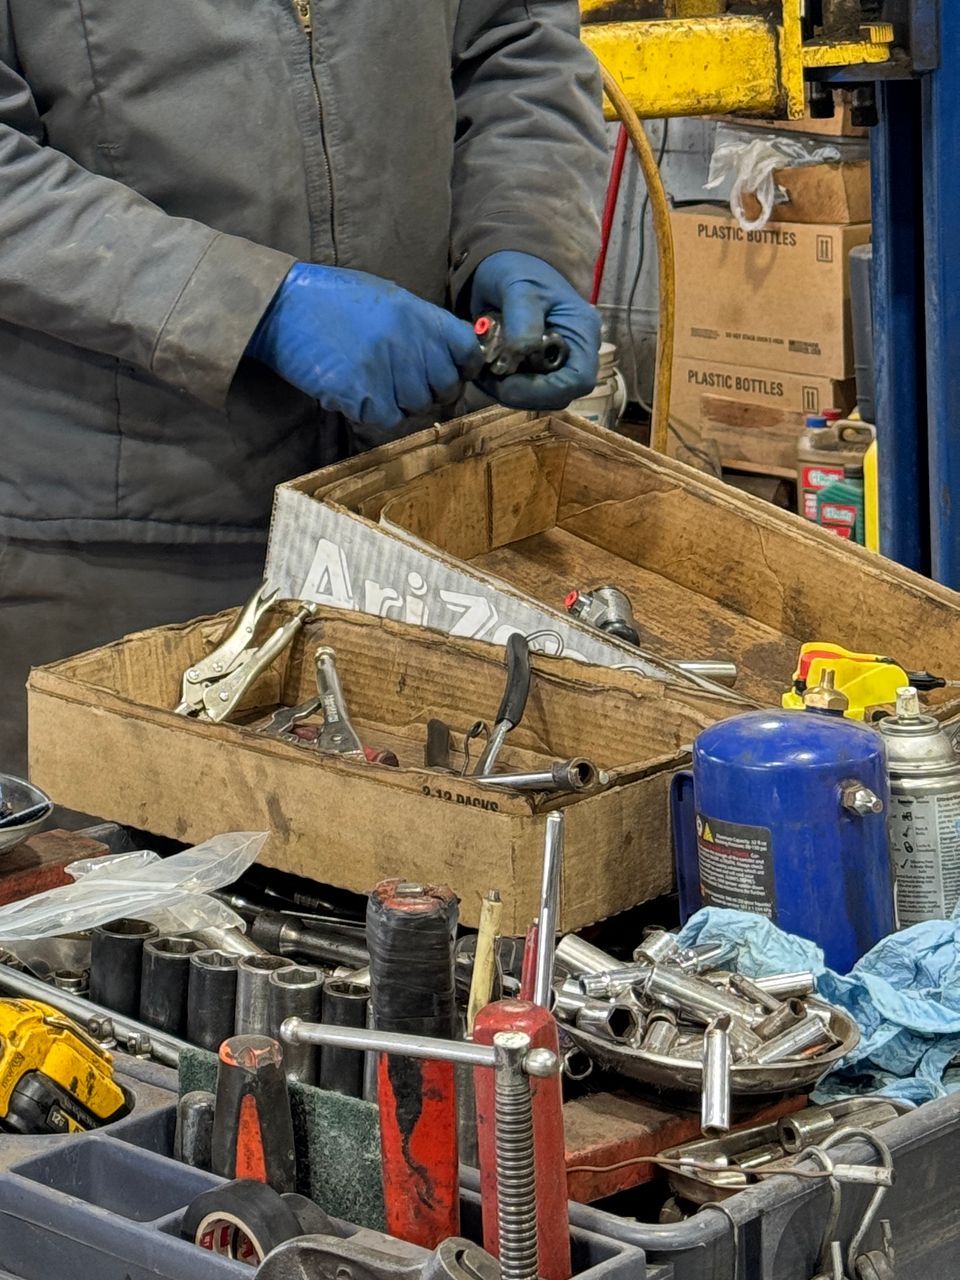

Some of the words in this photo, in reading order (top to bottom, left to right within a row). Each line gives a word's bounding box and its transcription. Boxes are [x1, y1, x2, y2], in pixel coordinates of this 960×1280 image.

[697, 223, 744, 241] PLASTIC
[746, 229, 797, 247] BOTTLES
[687, 369, 733, 389] PLASTIC
[735, 376, 784, 397] BOTTLES
